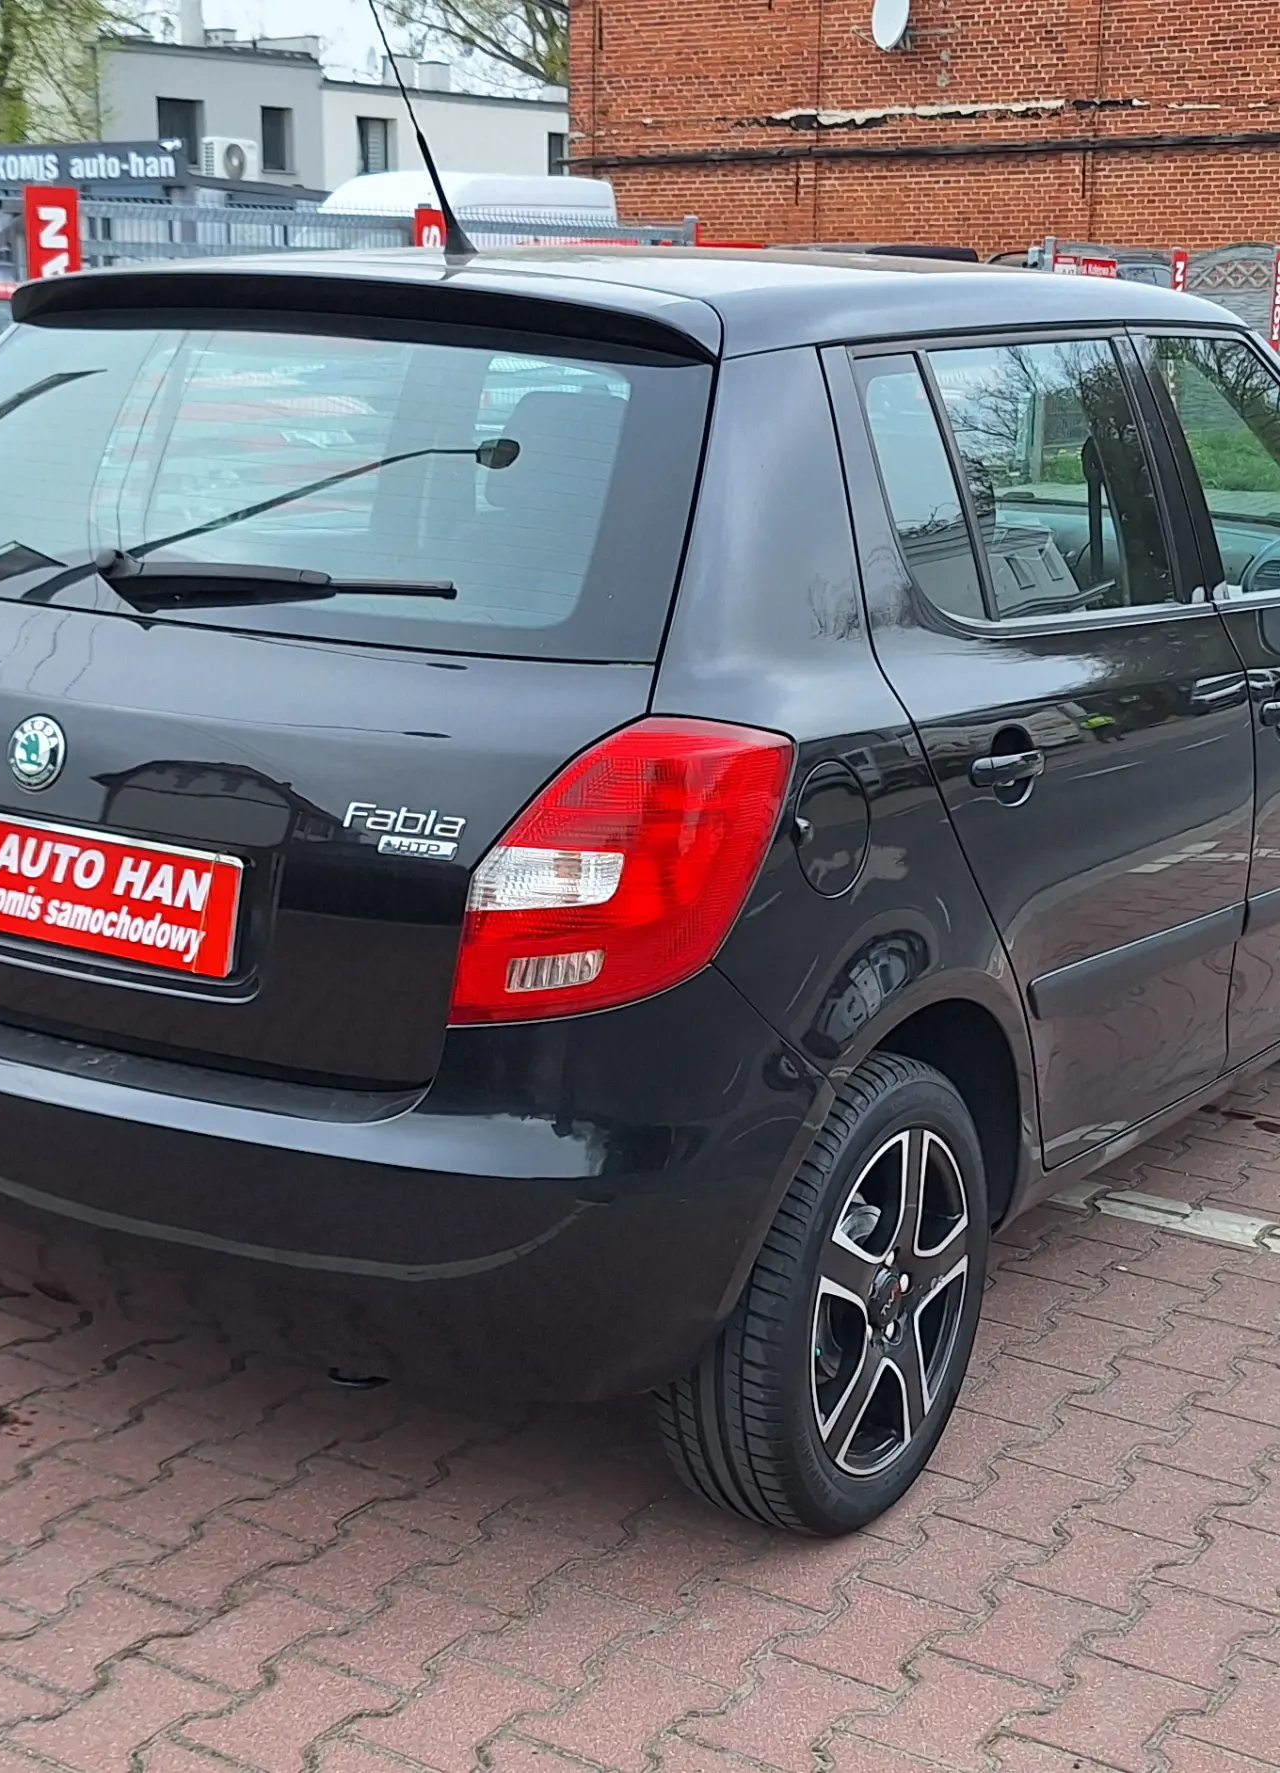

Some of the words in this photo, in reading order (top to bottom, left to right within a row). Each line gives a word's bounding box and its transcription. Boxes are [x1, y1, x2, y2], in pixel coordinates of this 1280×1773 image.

[70, 151, 177, 181] auto-han
[342, 801, 467, 838] Fabia
[112, 856, 212, 912] HAN
[43, 898, 207, 963] samochodowy
